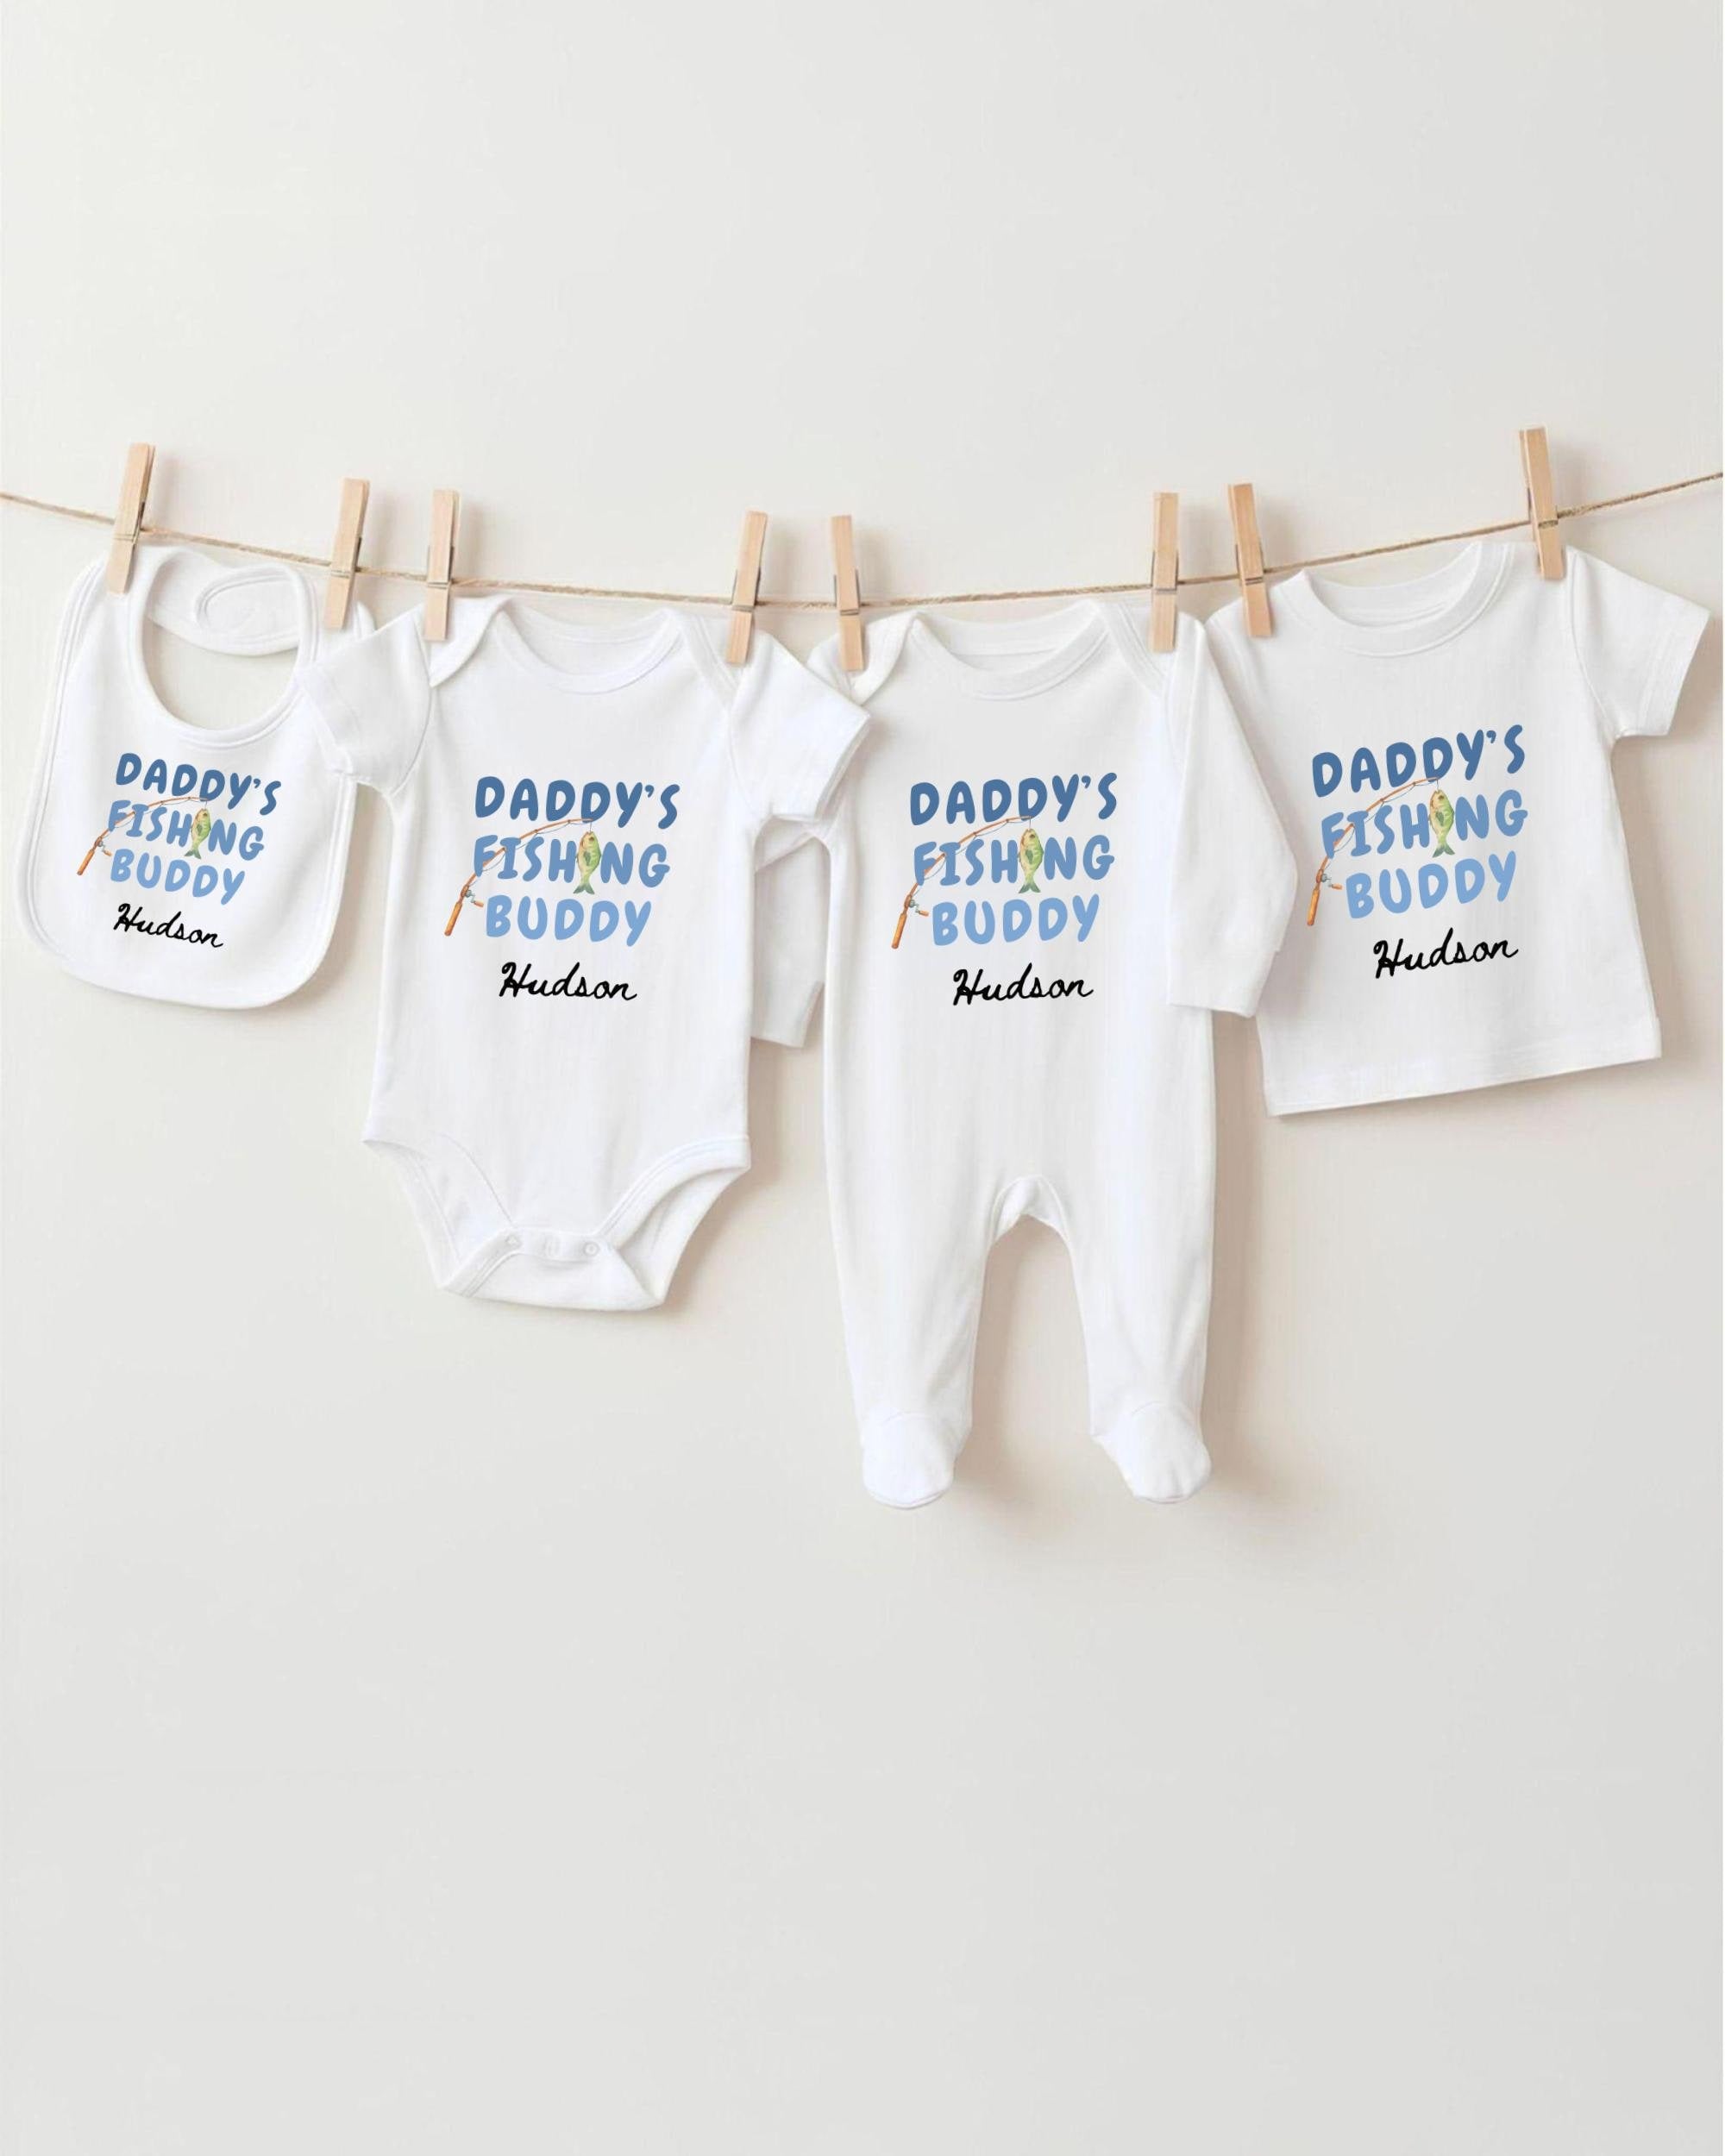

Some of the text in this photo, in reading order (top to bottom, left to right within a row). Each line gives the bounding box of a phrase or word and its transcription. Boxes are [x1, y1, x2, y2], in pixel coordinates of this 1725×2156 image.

[116, 753, 281, 815] DADDY’S
[1312, 724, 1525, 797] DADDY’S
[475, 776, 680, 830] DADDY’S
[910, 773, 1117, 825] DADDY’S
[1321, 789, 1528, 859] FISHNG
[108, 799, 265, 861] FISHNG
[110, 849, 245, 906] BUDDY
[474, 835, 670, 888] FISHNG
[913, 835, 1114, 886] FISHNG
[1346, 850, 1516, 918] BUDDY
[113, 903, 223, 948] Hudson
[486, 894, 651, 947] BUDDY
[932, 893, 1100, 946] BUDDY
[1373, 927, 1518, 979] Hudson
[499, 962, 637, 1000] Hudson
[953, 962, 1094, 1006] Hudson
